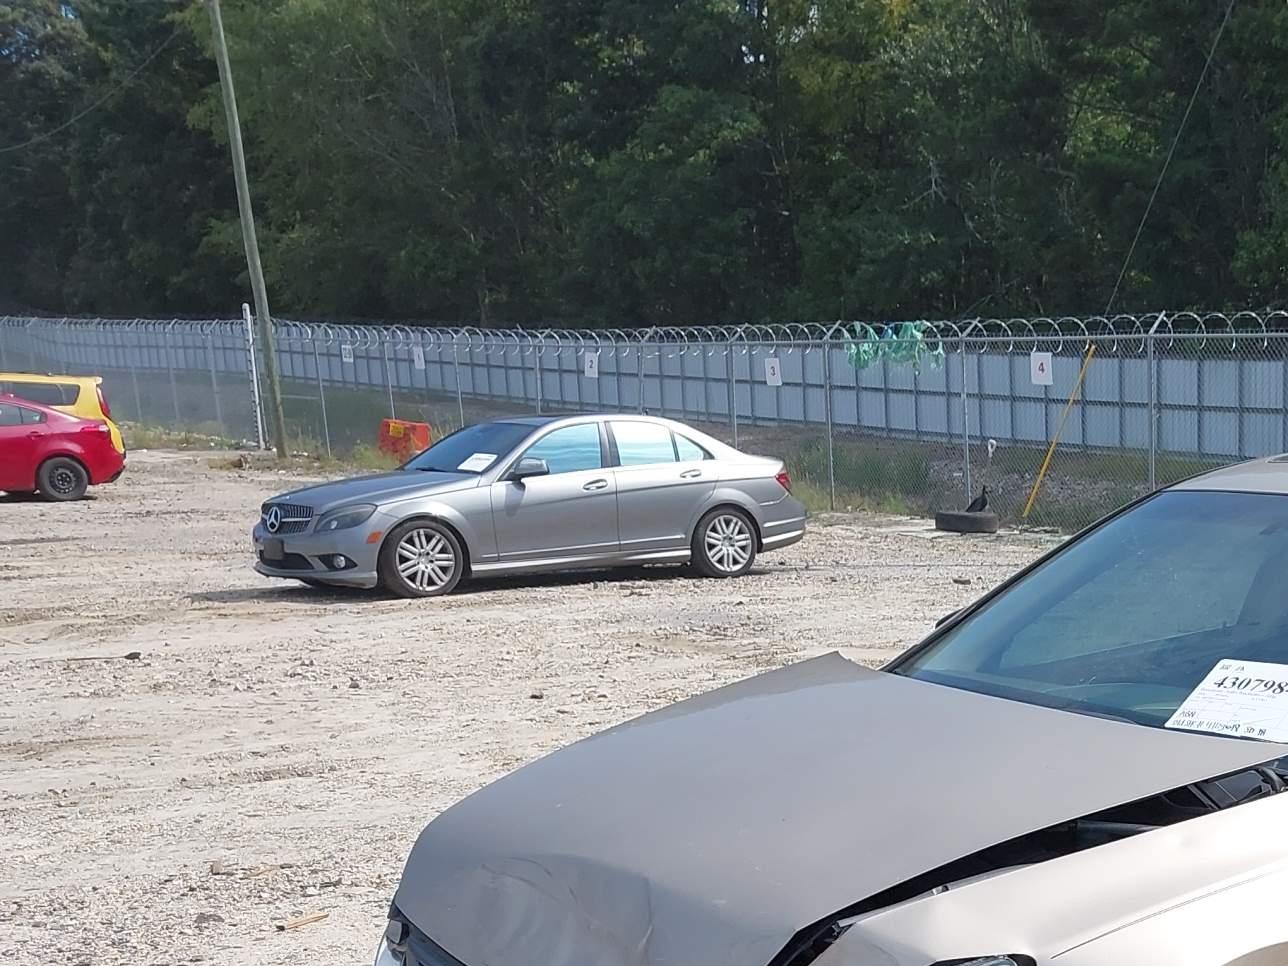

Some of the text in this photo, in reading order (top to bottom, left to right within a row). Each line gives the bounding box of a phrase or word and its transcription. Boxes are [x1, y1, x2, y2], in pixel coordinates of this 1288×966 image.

[589, 359, 594, 369] 2
[1038, 362, 1045, 374] 4
[770, 365, 776, 377] 3
